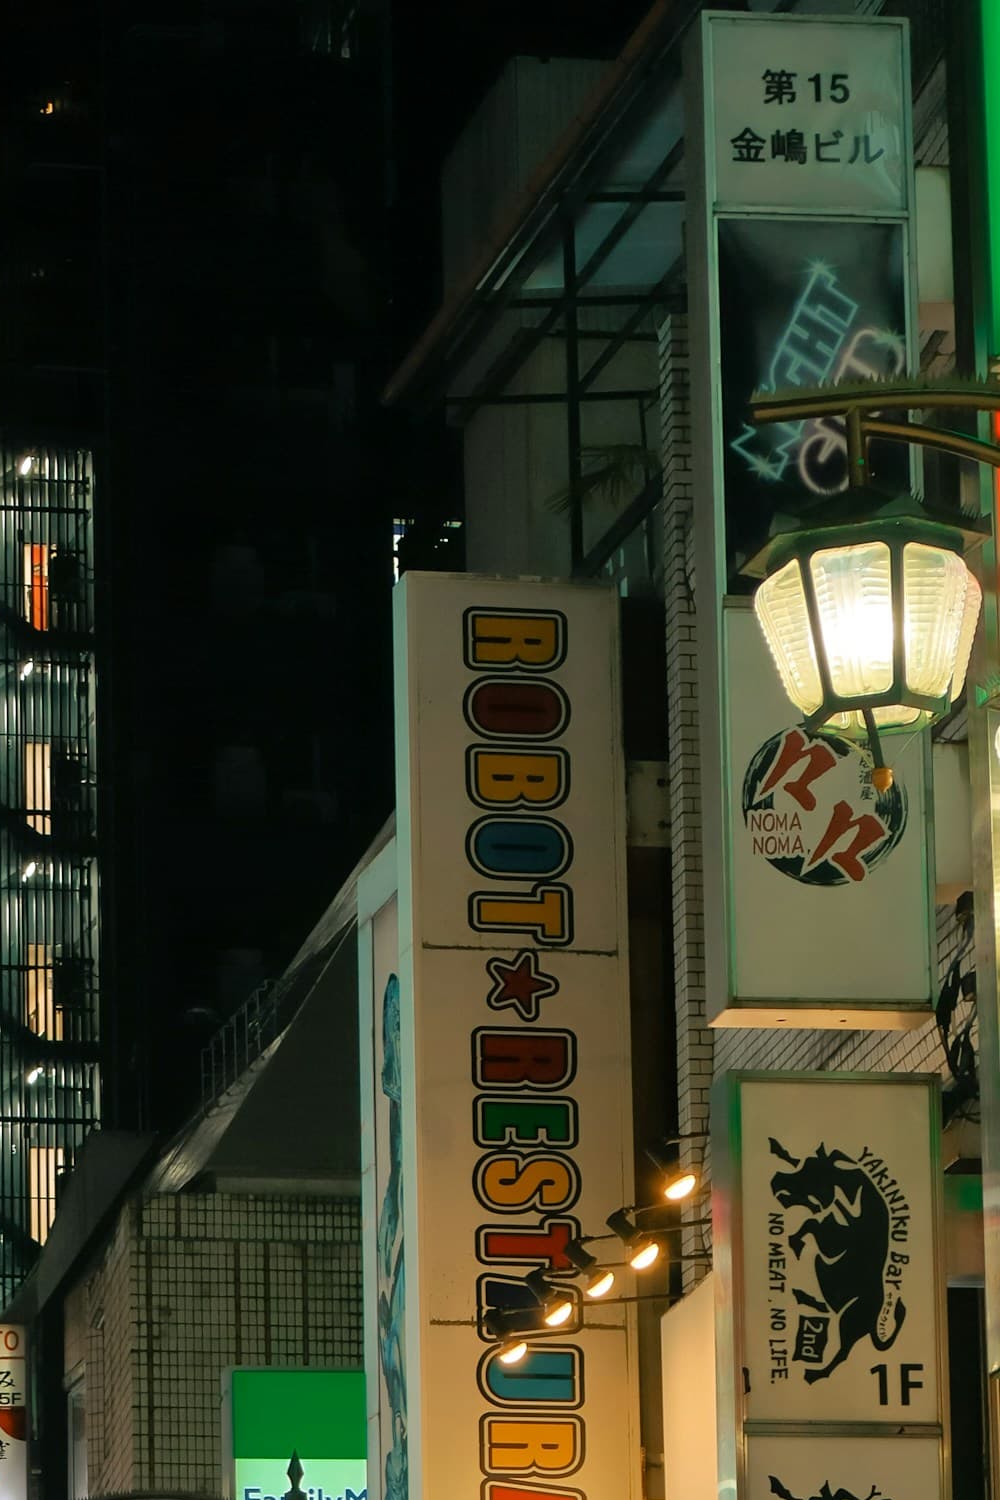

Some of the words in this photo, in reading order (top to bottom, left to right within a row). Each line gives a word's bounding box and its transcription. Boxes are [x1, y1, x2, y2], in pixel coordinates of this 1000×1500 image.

[762, 69, 851, 105] 第15
[463, 606, 573, 947] ROBOT
[750, 812, 802, 833] NOMA
[768, 1212, 785, 1236] NO
[856, 1146, 911, 1242] YAKINIKU
[885, 1252, 910, 1290] Bar
[770, 1308, 787, 1332] NO
[802, 1319, 824, 1359] 2nd
[0, 1393, 22, 1405] 5F
[870, 1363, 924, 1406] 1F
